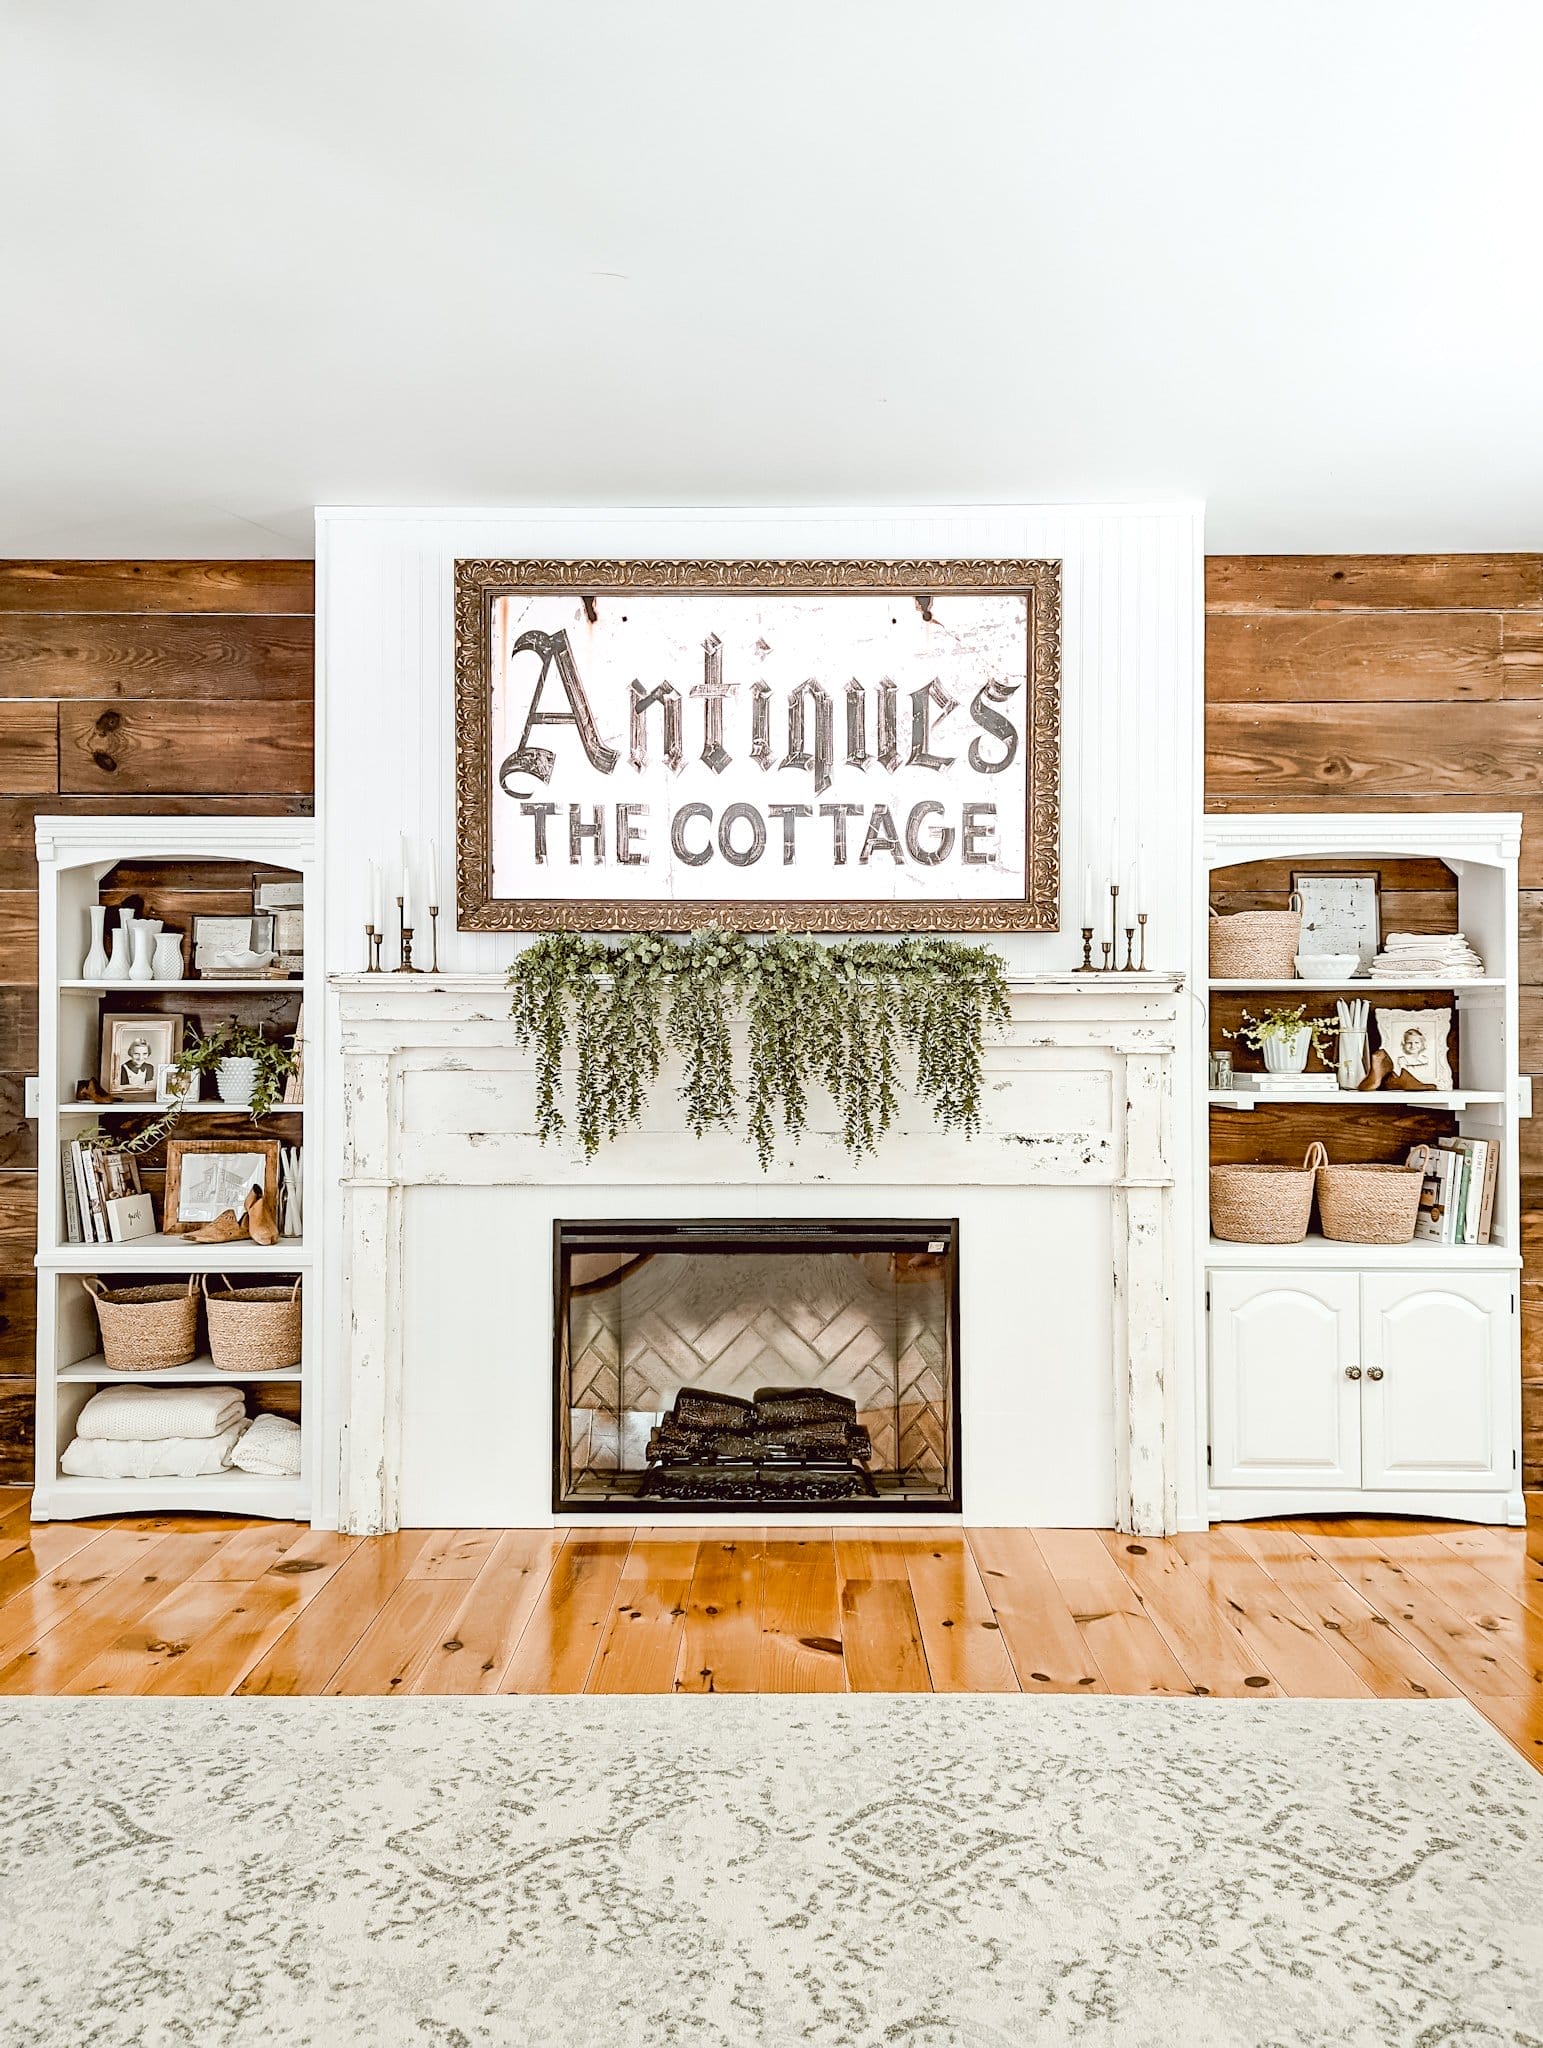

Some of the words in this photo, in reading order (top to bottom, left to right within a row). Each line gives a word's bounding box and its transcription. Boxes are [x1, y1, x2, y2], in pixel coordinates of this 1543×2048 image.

[499, 628, 1021, 799] Antiques
[520, 802, 650, 867] THE
[671, 800, 997, 867] COTTAGE
[63, 1150, 73, 1187] CURATE
